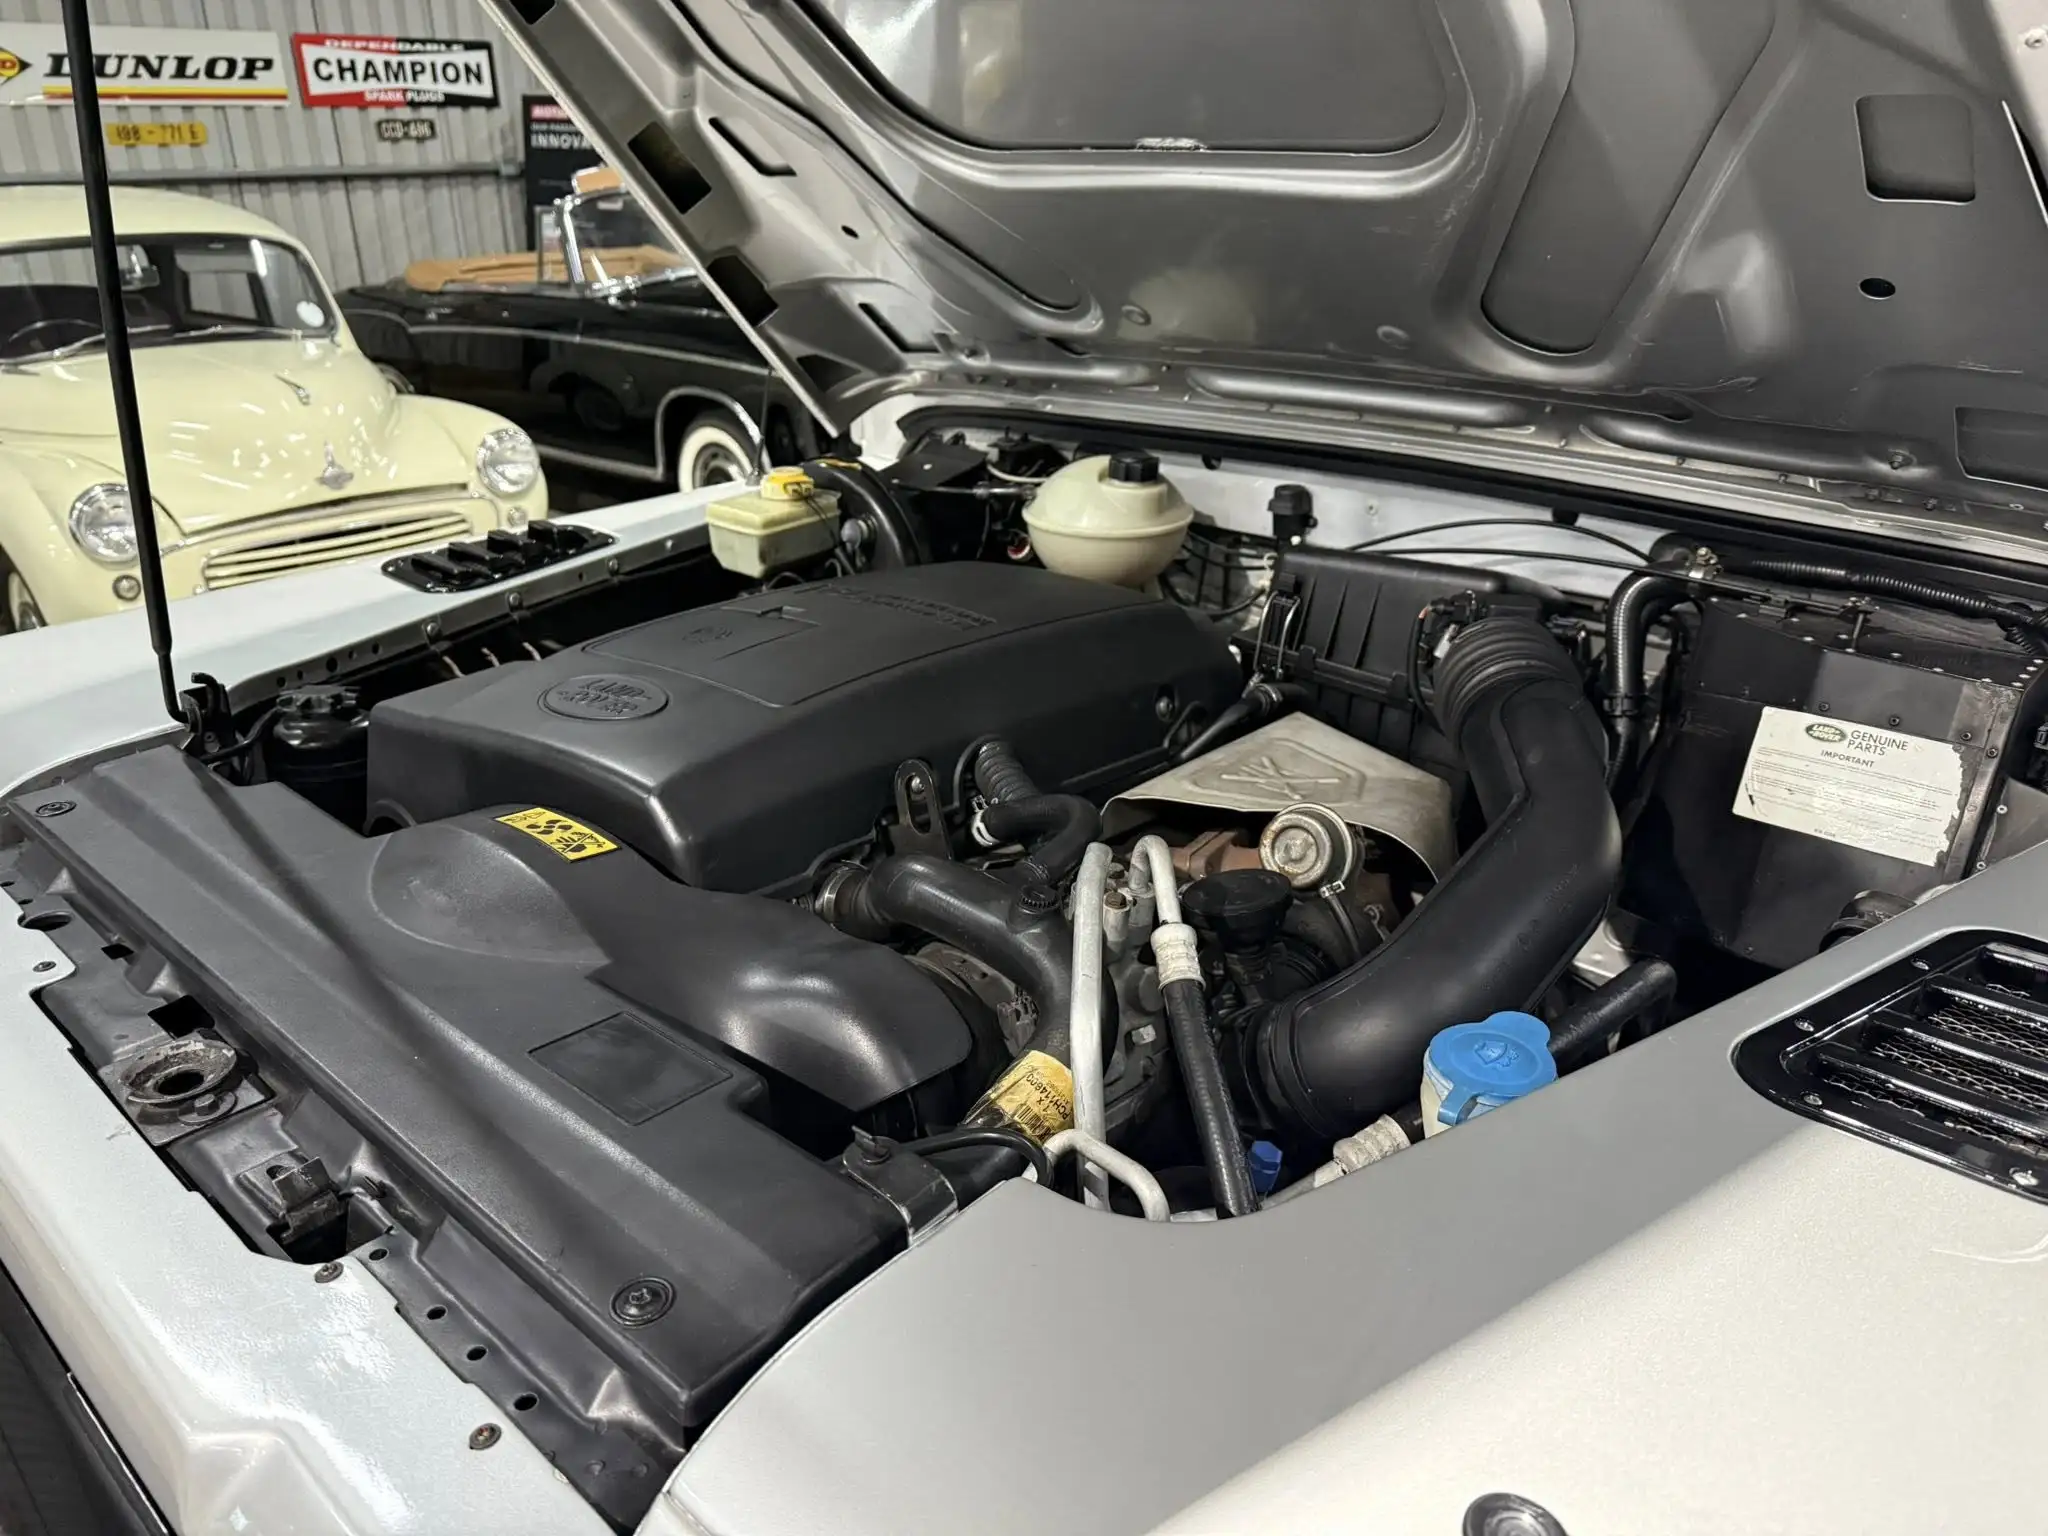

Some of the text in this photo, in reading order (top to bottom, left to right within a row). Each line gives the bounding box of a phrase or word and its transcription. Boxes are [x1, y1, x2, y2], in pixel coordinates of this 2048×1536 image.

[324, 38, 464, 52] DEPENDABLE
[313, 57, 483, 85] CHAMPION
[364, 89, 446, 103] SPARK PLUGS
[1812, 731, 1842, 743] ROVER
[1850, 730, 1909, 751] GENUINE
[1847, 739, 1886, 757] PARTS
[1820, 749, 1875, 768] IMPORTANT
